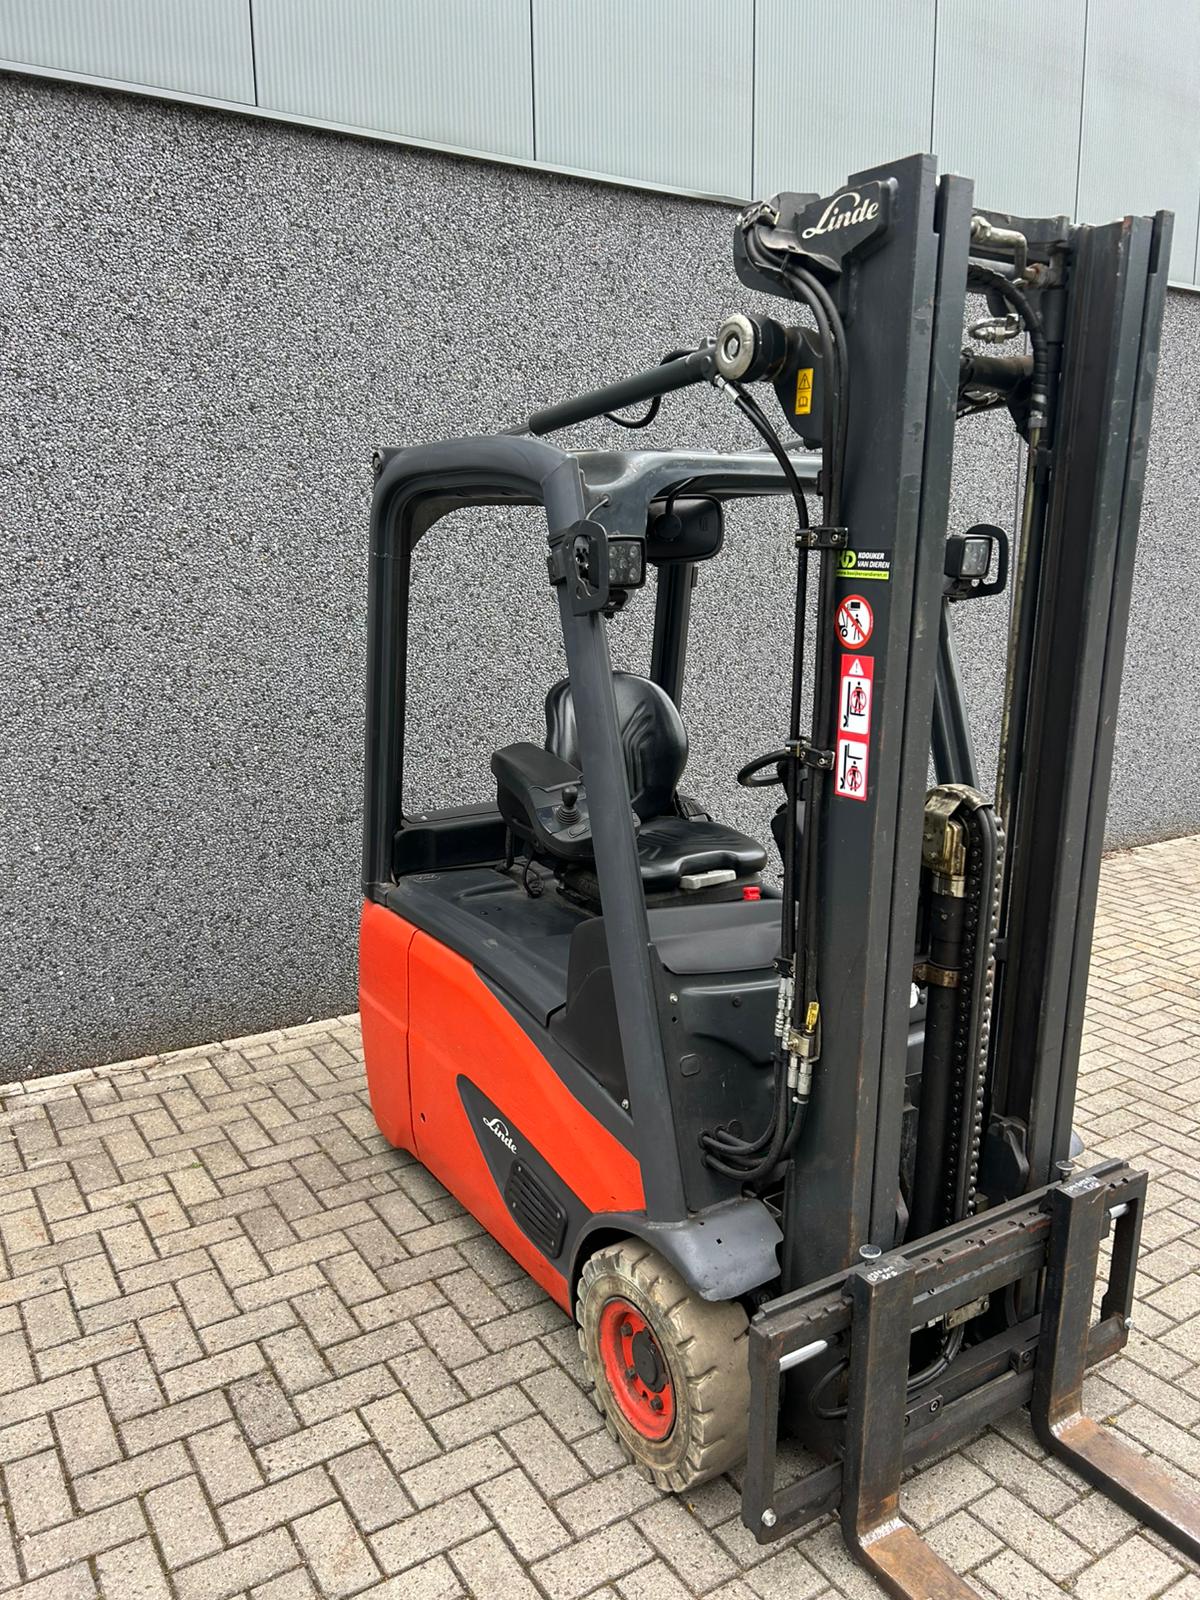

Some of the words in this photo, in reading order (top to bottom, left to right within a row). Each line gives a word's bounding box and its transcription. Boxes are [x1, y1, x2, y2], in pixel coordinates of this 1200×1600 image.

[801, 192, 879, 239] Linde
[857, 560, 869, 568] VAN
[869, 561, 890, 569] DIEREN
[482, 1116, 517, 1155] Linde
